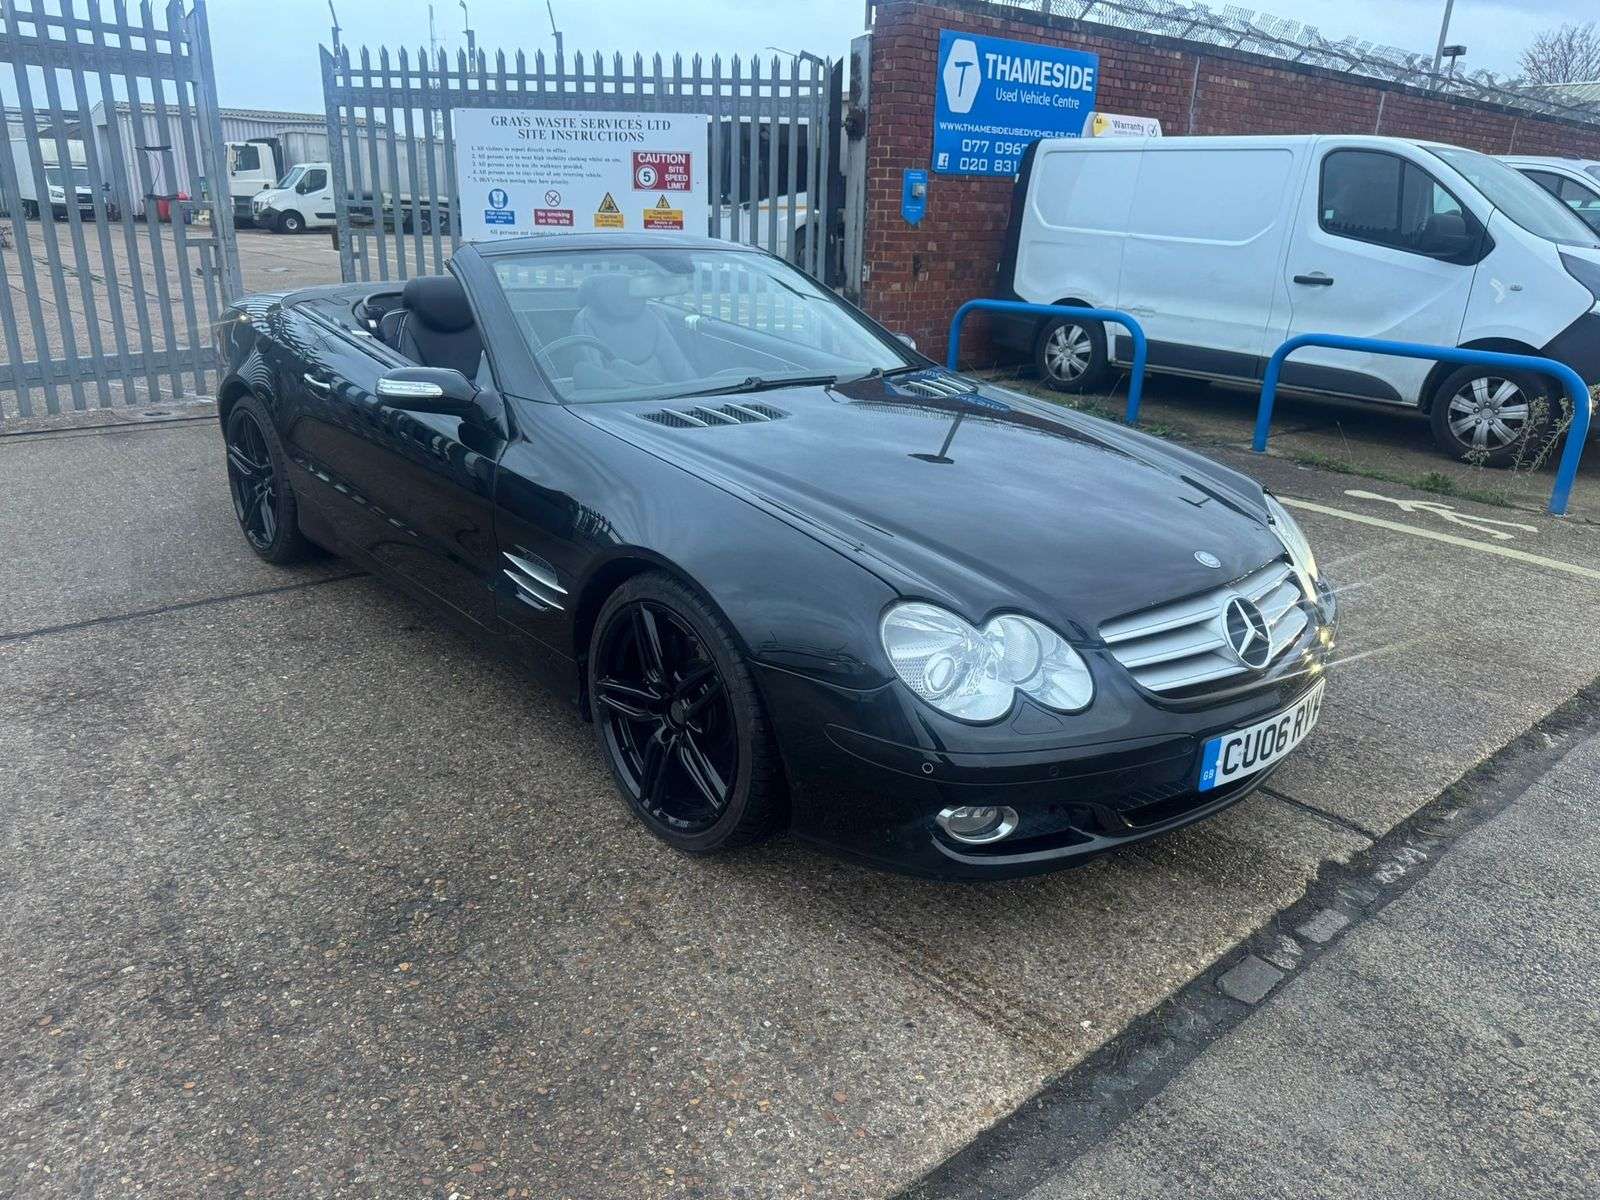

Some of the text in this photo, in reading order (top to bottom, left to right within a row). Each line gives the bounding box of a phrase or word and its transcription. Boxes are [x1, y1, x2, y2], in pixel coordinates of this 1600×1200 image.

[985, 52, 1094, 92] THAMESIDE
[996, 88, 1080, 109] Used Vehicle Centre
[491, 116, 671, 130] GRAYS WASTE SERVICES LTD
[1112, 120, 1144, 132] Warranty
[518, 128, 644, 142] SITE INSTRUCTIONS
[962, 139, 990, 153] 077
[638, 153, 686, 164] CAUTION
[960, 158, 988, 170] 020
[644, 172, 651, 182] 5
[1222, 716, 1291, 776] CU06
[1203, 768, 1214, 780] GB
